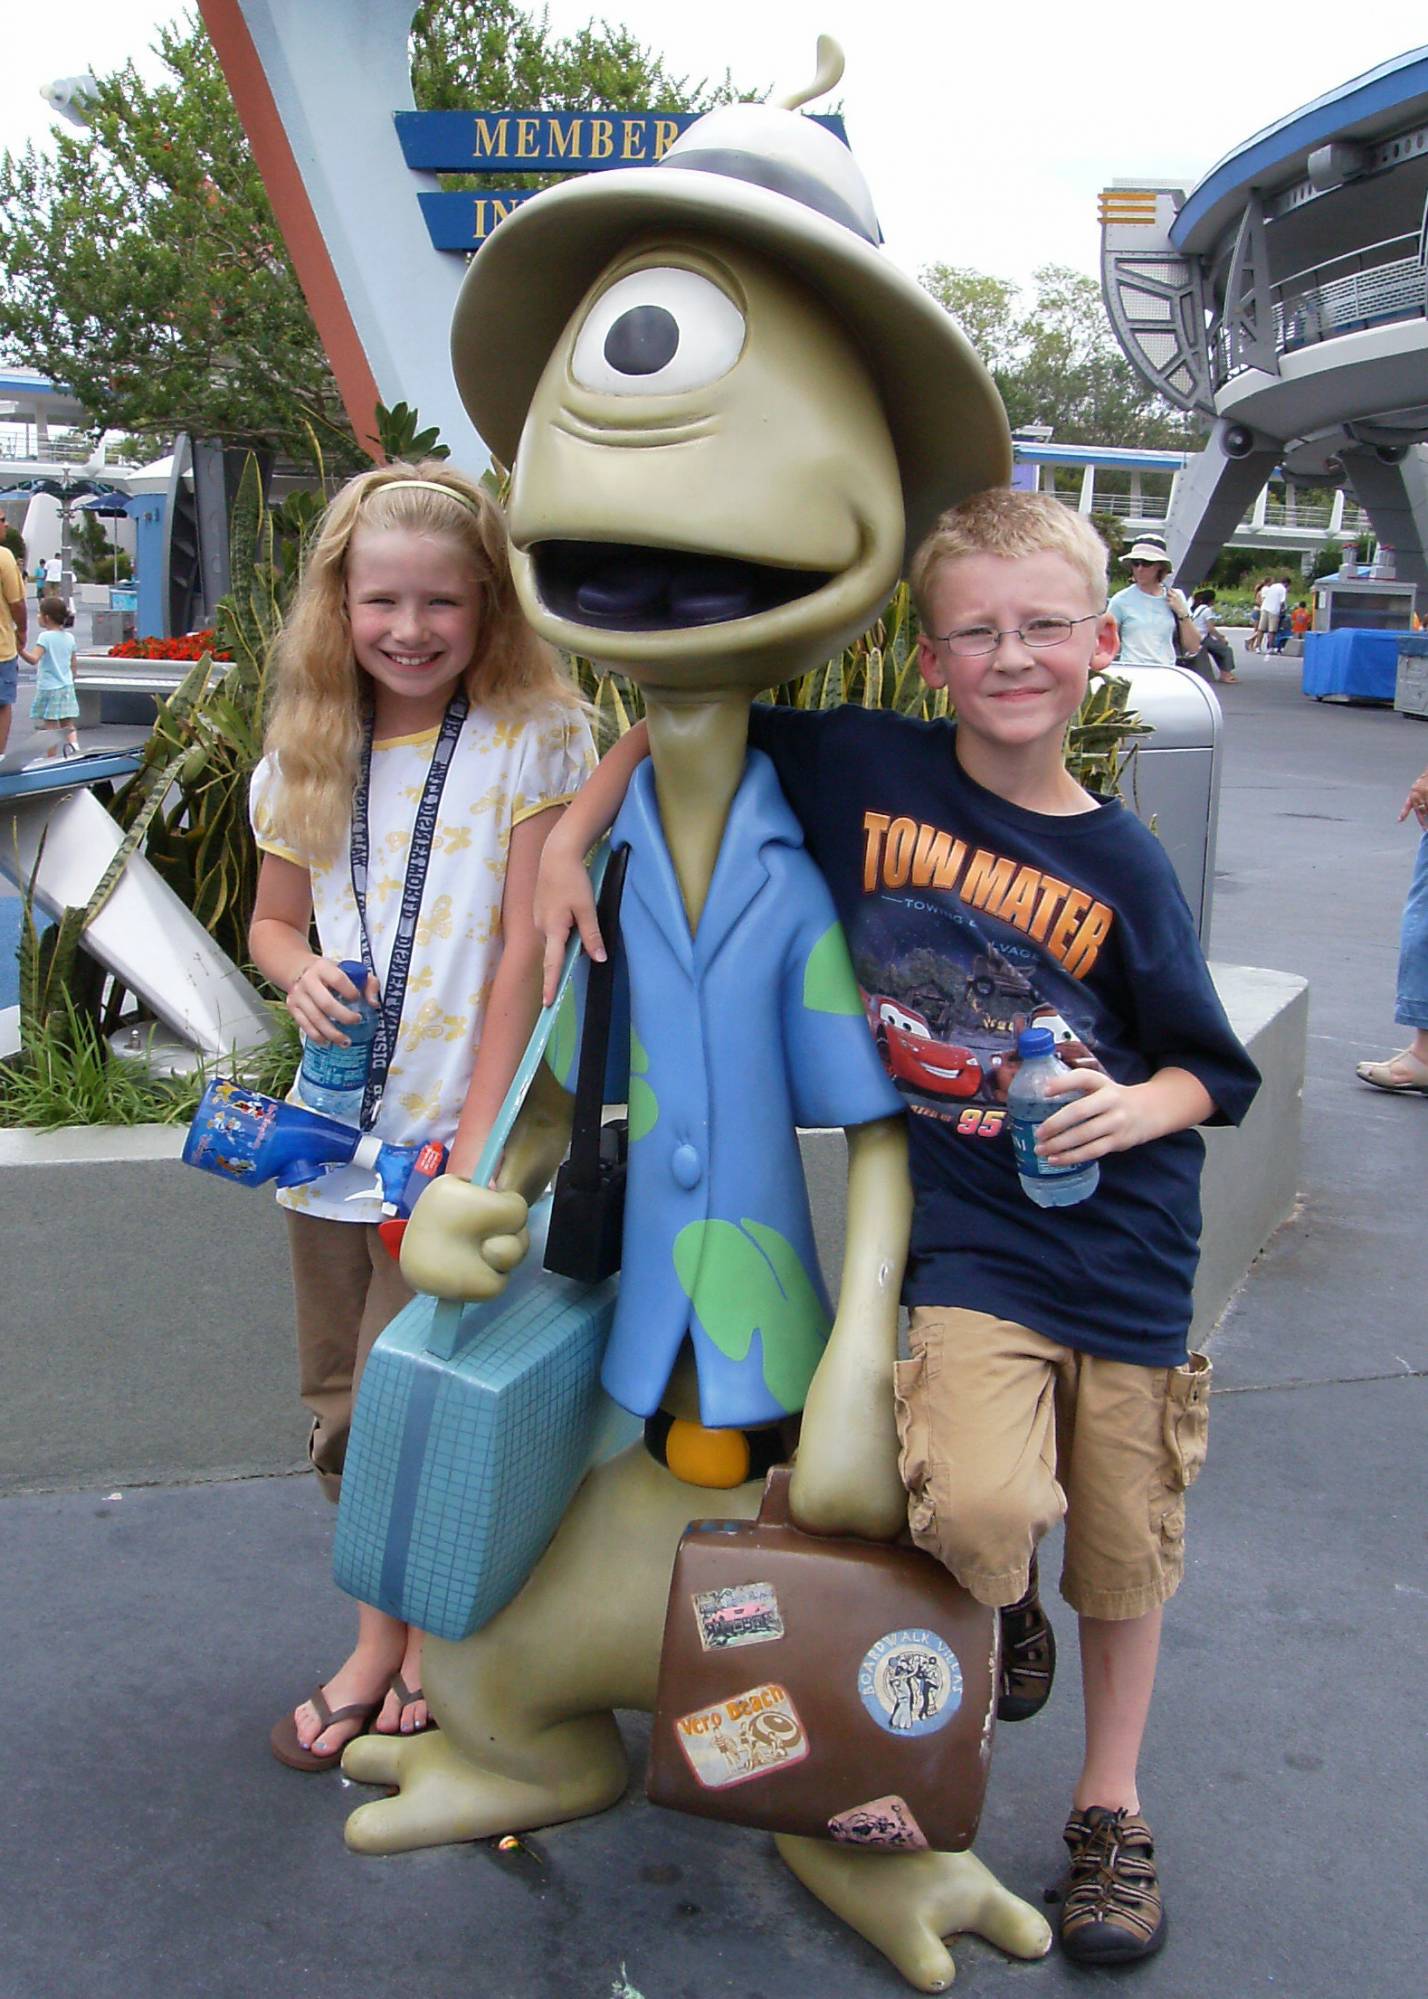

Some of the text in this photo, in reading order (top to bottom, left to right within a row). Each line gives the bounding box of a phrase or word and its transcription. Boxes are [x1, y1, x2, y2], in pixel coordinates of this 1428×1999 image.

[473, 200, 528, 238] IN
[863, 810, 1114, 981] TOW MATER
[957, 1108, 1008, 1137] 95
[861, 1632, 963, 1695] BOARDWALK VILLAS
[680, 1685, 784, 1736] Vero Beach
